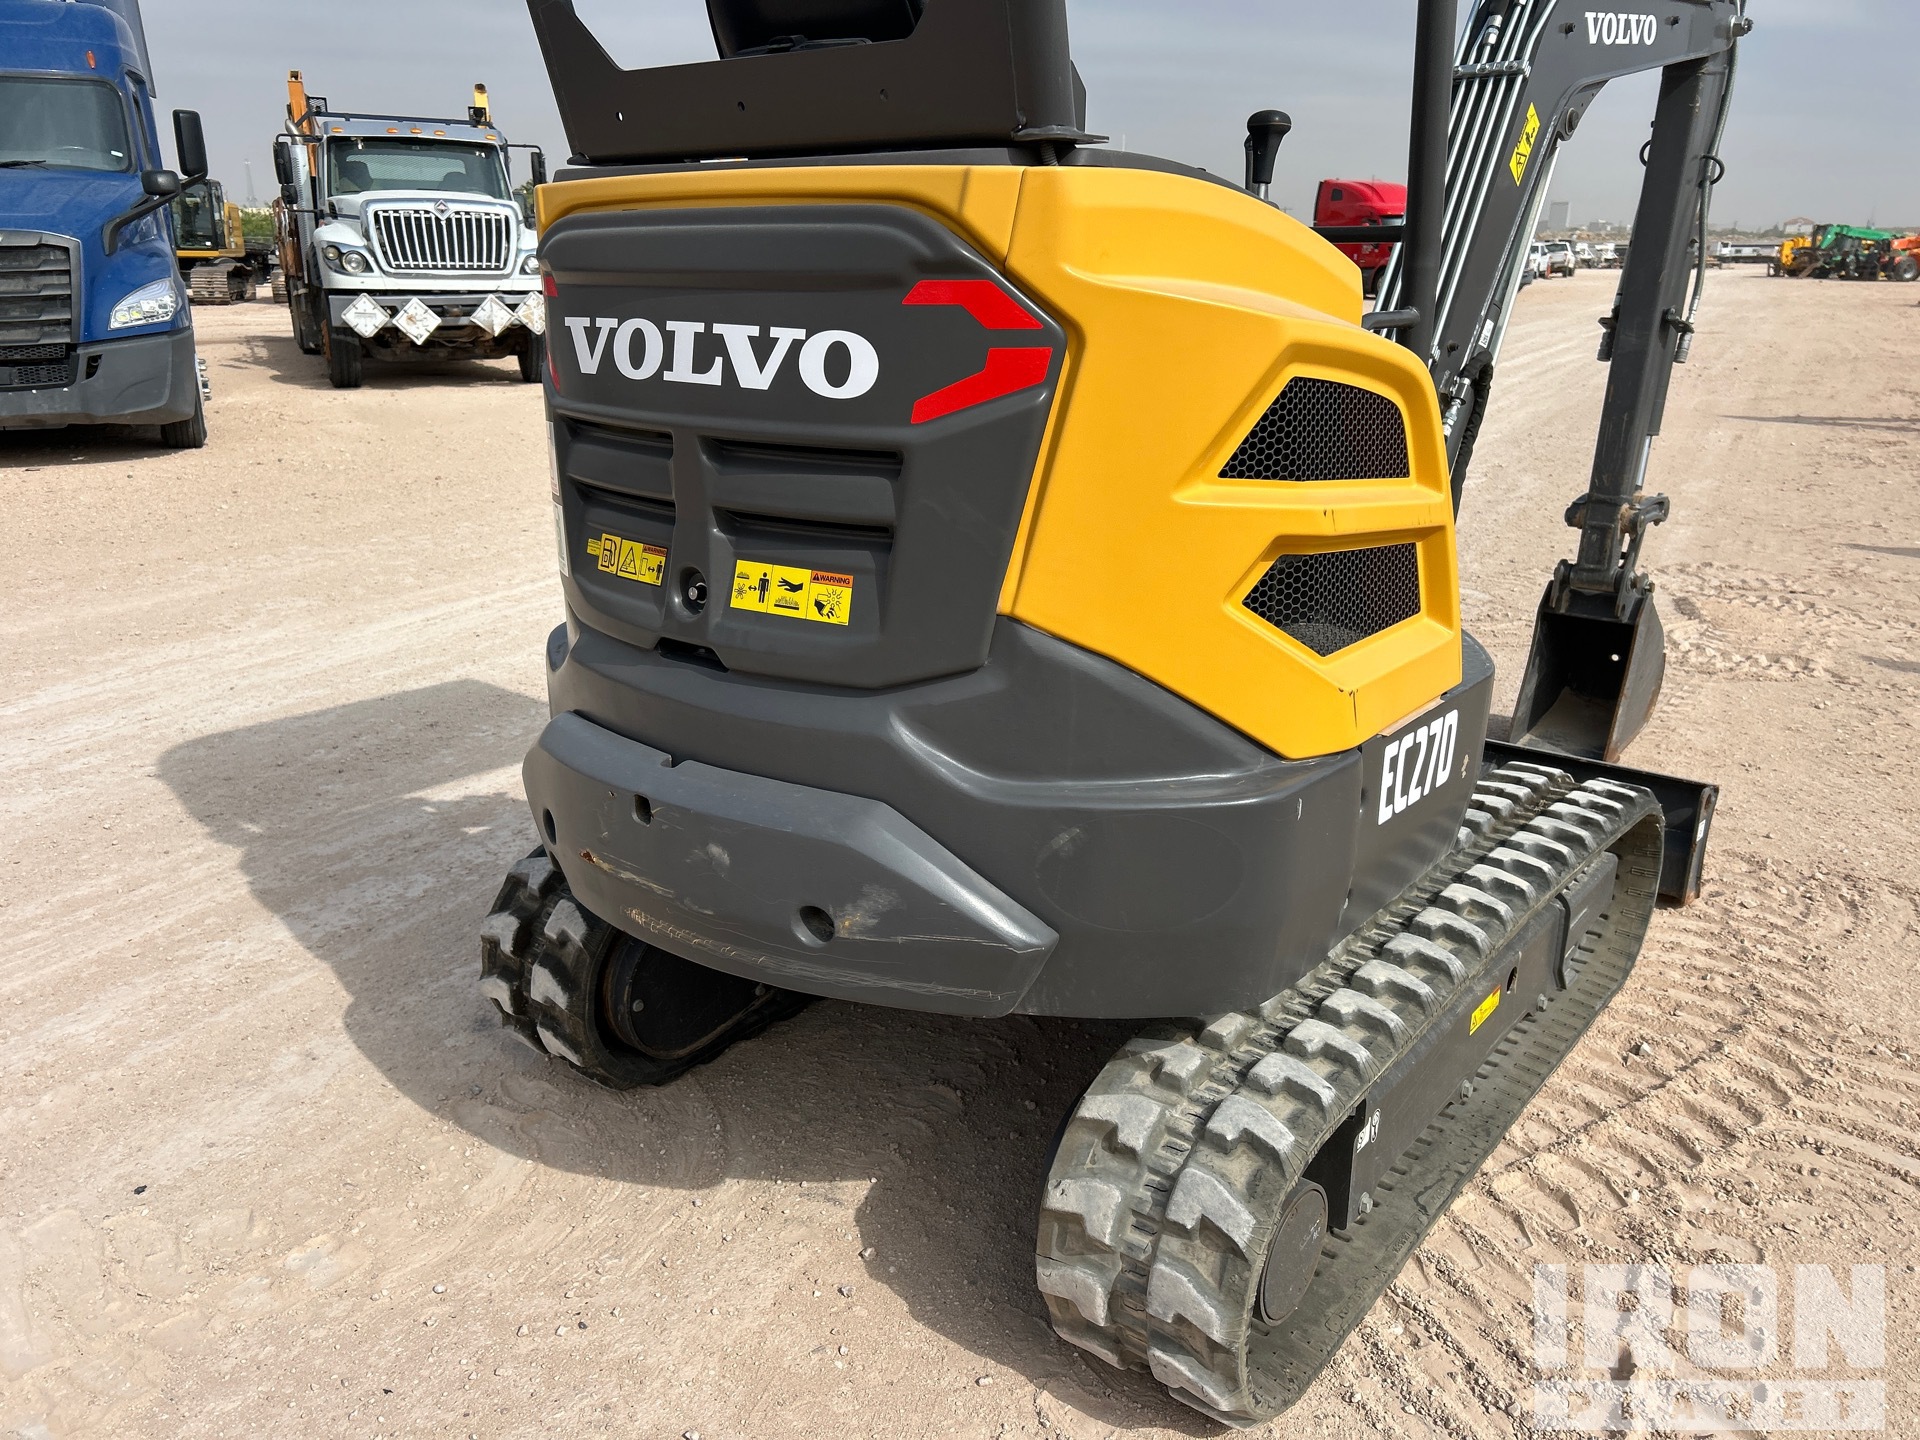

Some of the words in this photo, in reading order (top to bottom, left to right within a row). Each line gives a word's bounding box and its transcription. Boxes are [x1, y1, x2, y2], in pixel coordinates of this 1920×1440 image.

[1584, 11, 1657, 46] VOLVO
[564, 316, 879, 400] VOLVO
[647, 546, 667, 555] WARNING
[820, 574, 851, 585] WARNING
[1378, 709, 1459, 825] EC27D
